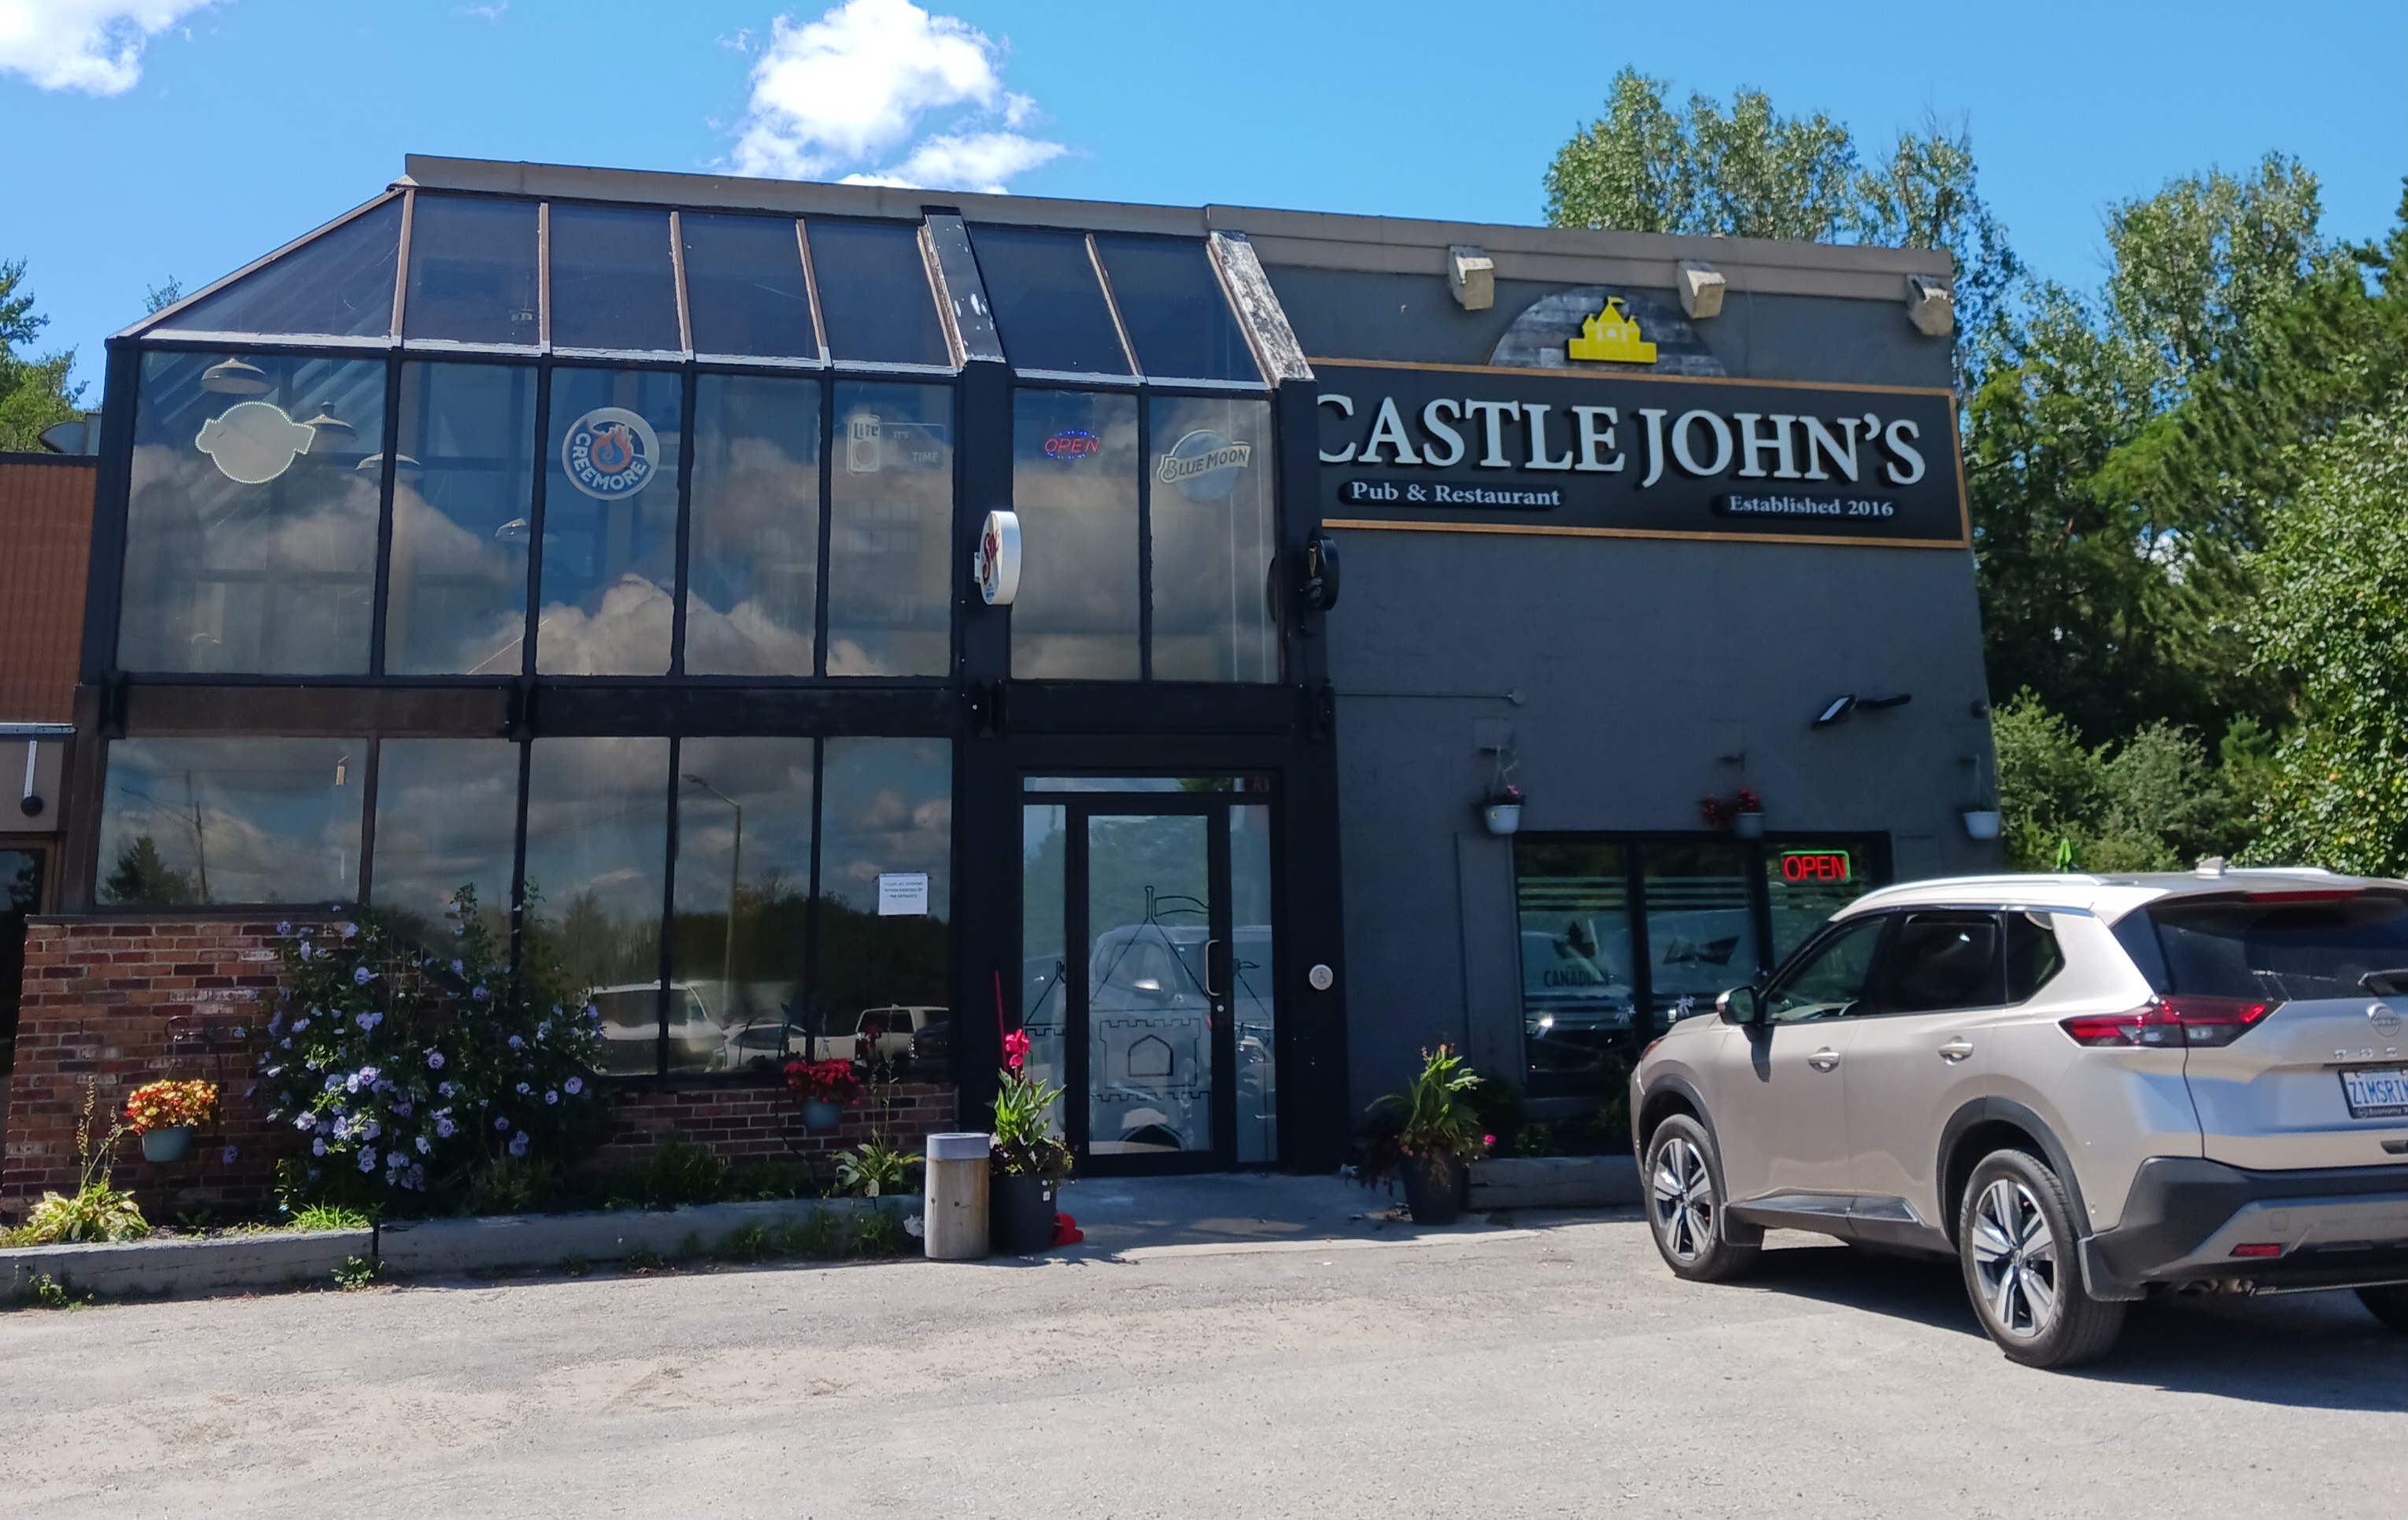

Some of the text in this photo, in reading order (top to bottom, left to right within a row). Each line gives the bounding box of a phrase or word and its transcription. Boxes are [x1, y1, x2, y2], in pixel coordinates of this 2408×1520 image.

[853, 423, 879, 440] Lite
[1317, 394, 1926, 488] CASTLE JOHN'S
[911, 451, 939, 463] TIME
[1044, 438, 1100, 453] OPEN
[572, 432, 648, 490] CREEMORE
[1162, 448, 1247, 482] BLUE MOON
[1351, 481, 1561, 506] Pub & Restaurant
[1729, 495, 1894, 516] Established 2016
[1782, 855, 1847, 882] OPEN
